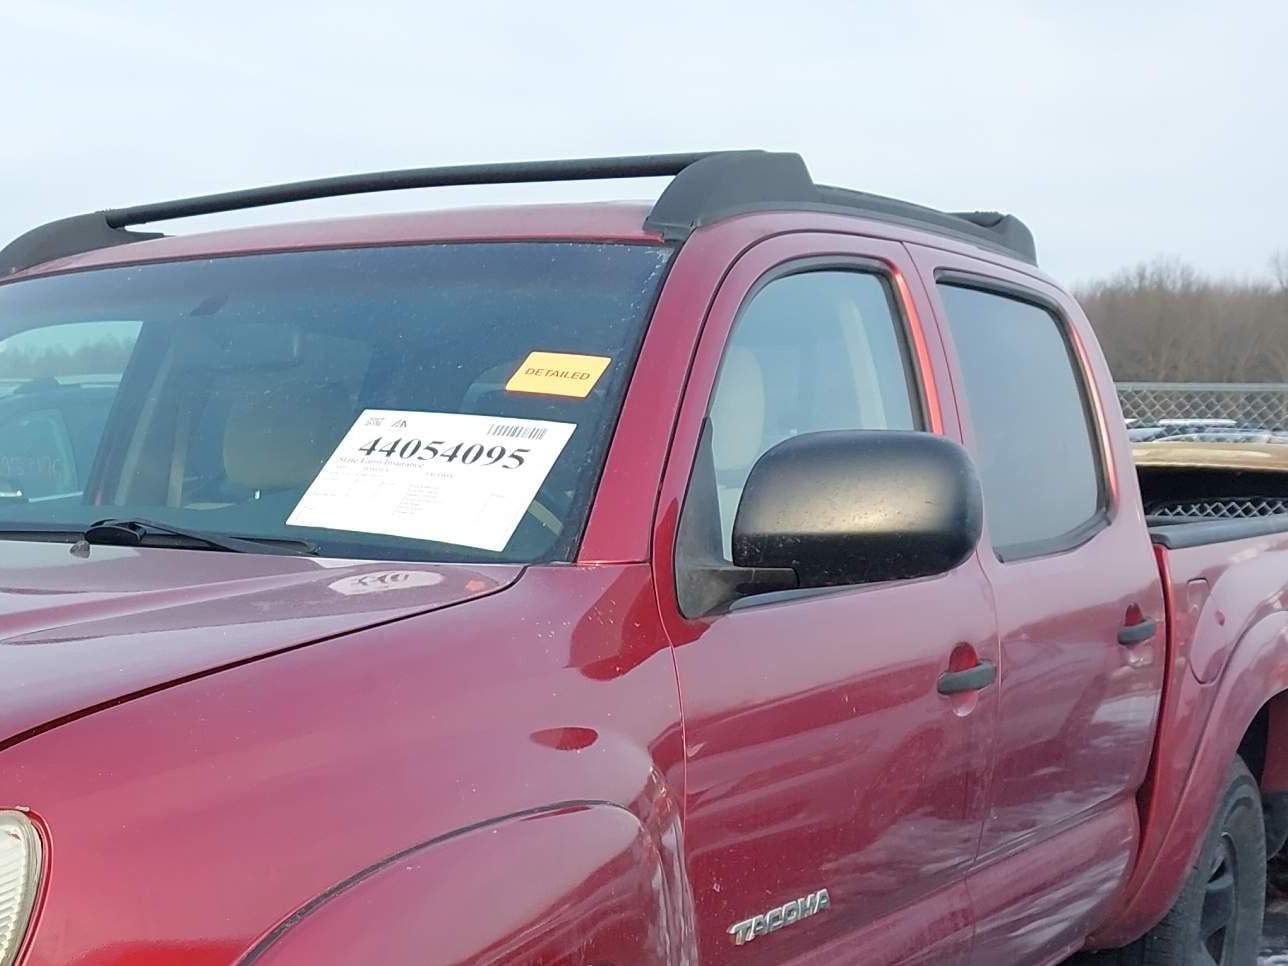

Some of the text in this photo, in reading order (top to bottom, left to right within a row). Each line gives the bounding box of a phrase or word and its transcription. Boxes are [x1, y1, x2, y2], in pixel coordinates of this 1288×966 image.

[525, 367, 590, 381] DETAILED
[358, 436, 530, 470] 44054095
[726, 888, 831, 946] TACOMA
